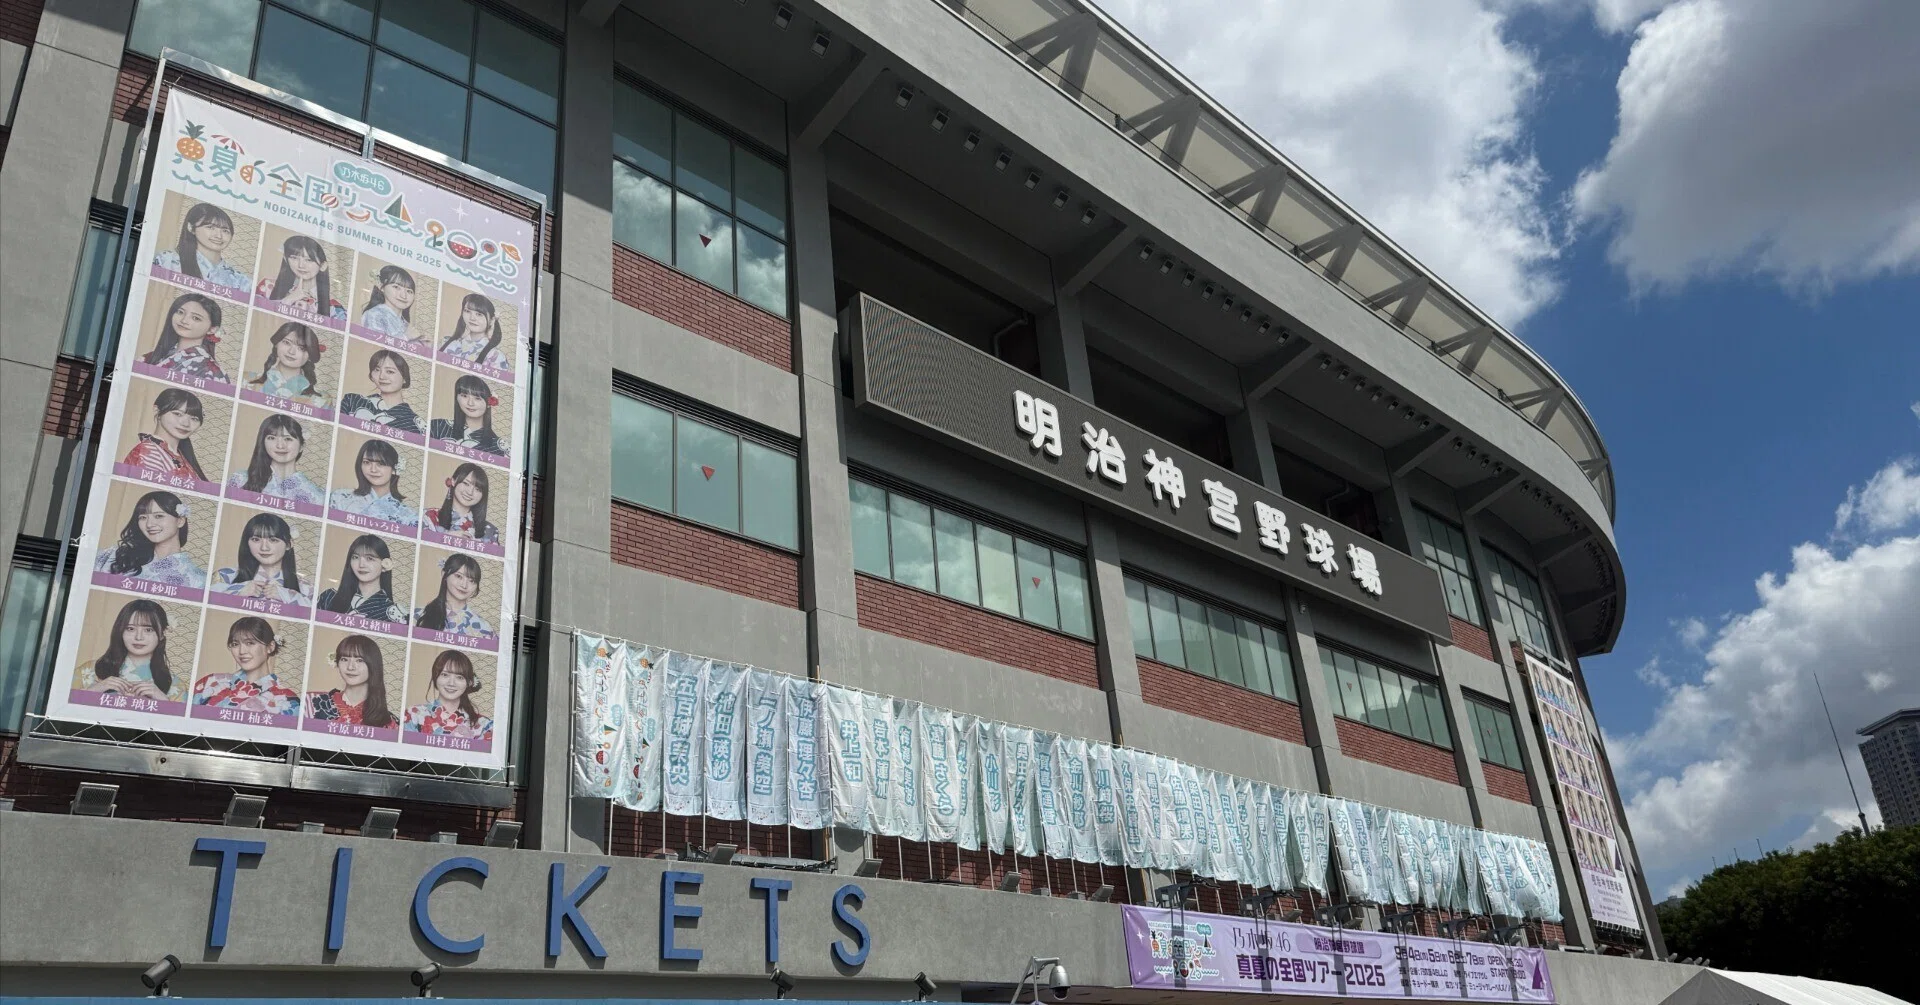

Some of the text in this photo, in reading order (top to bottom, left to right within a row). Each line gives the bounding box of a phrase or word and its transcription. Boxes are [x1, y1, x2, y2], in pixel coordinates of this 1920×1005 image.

[264, 200, 441, 268] NOGIZAKA46 SUMMER TOUR 2025
[278, 304, 300, 320] 池田
[166, 370, 205, 388] 井上 和
[265, 395, 287, 408] 岩本
[468, 448, 495, 463] さくら
[141, 470, 166, 483] 岡本
[1013, 389, 1383, 596] 明治神宮野球場
[256, 494, 296, 510] 小川 彩
[345, 515, 401, 533] 奥田 いろは
[121, 577, 178, 596] 金川 紗耶
[268, 602, 282, 615] 桜
[333, 613, 355, 627] 久保
[434, 632, 479, 648] 黒見 明香
[99, 693, 127, 708] 佐藤
[219, 708, 244, 722] 柴田
[353, 725, 375, 738] 咲月
[425, 735, 471, 749] 田村 真佑
[195, 837, 873, 967] TICKETS
[1232, 927, 1292, 952] 乃木坂46
[1487, 955, 1503, 966] OPEN
[1236, 953, 1386, 987] 真夏の全国ツアー2025
